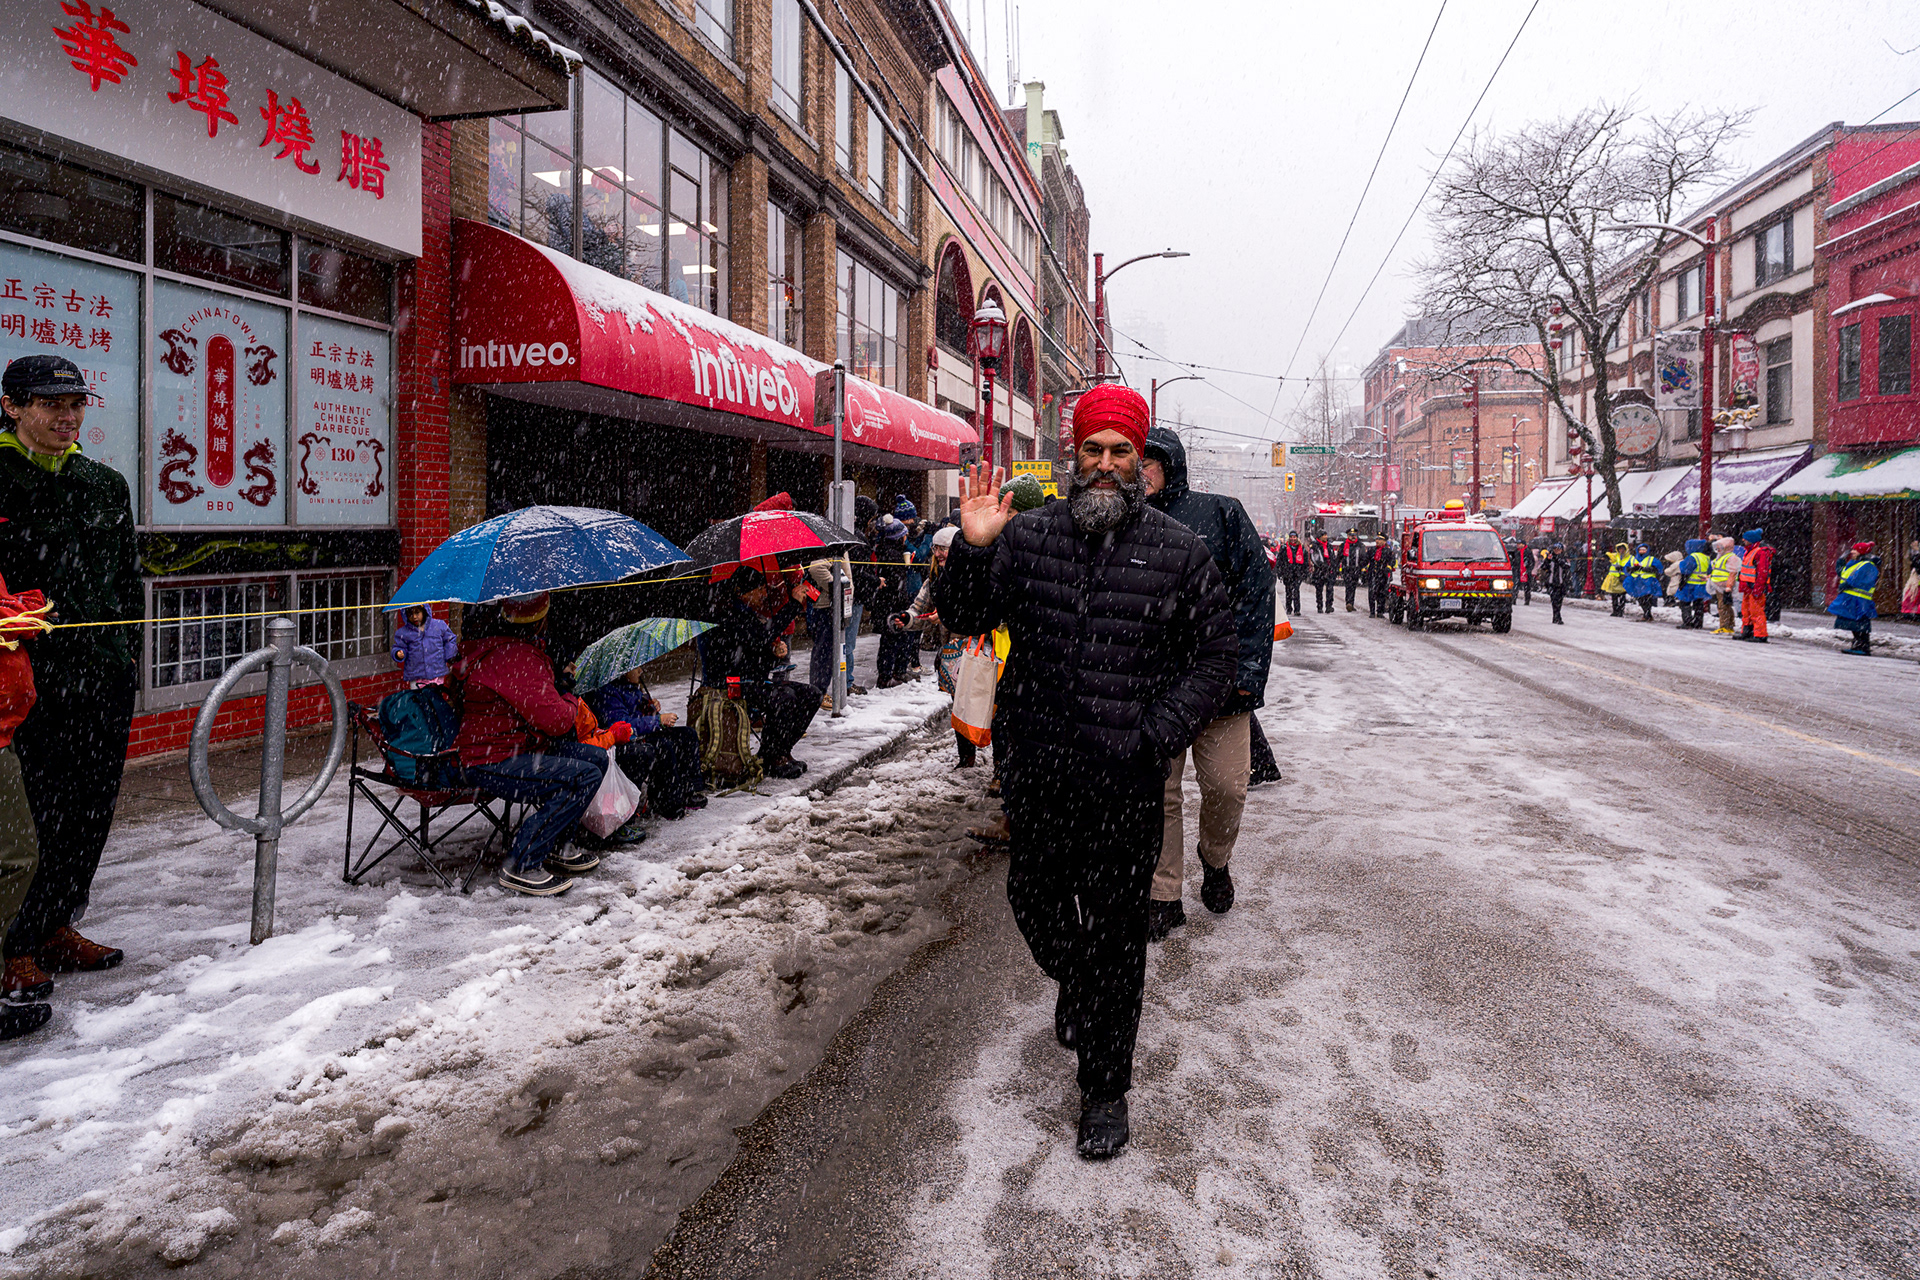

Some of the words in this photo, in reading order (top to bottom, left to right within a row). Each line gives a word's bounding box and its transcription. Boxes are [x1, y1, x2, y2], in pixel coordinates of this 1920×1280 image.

[1, 278, 114, 319] 正宗古法
[1, 313, 113, 353] 明爐燒烤
[182, 307, 257, 344] CHINATOWN
[310, 341, 375, 368] 正宗古法
[310, 367, 374, 394] 明爐燒烤
[313, 401, 371, 417] AUTHENTIC
[320, 412, 365, 426] CHINESE
[315, 422, 370, 436] BARBEQUE
[331, 447, 355, 462] 130
[207, 501, 233, 512] BBQ
